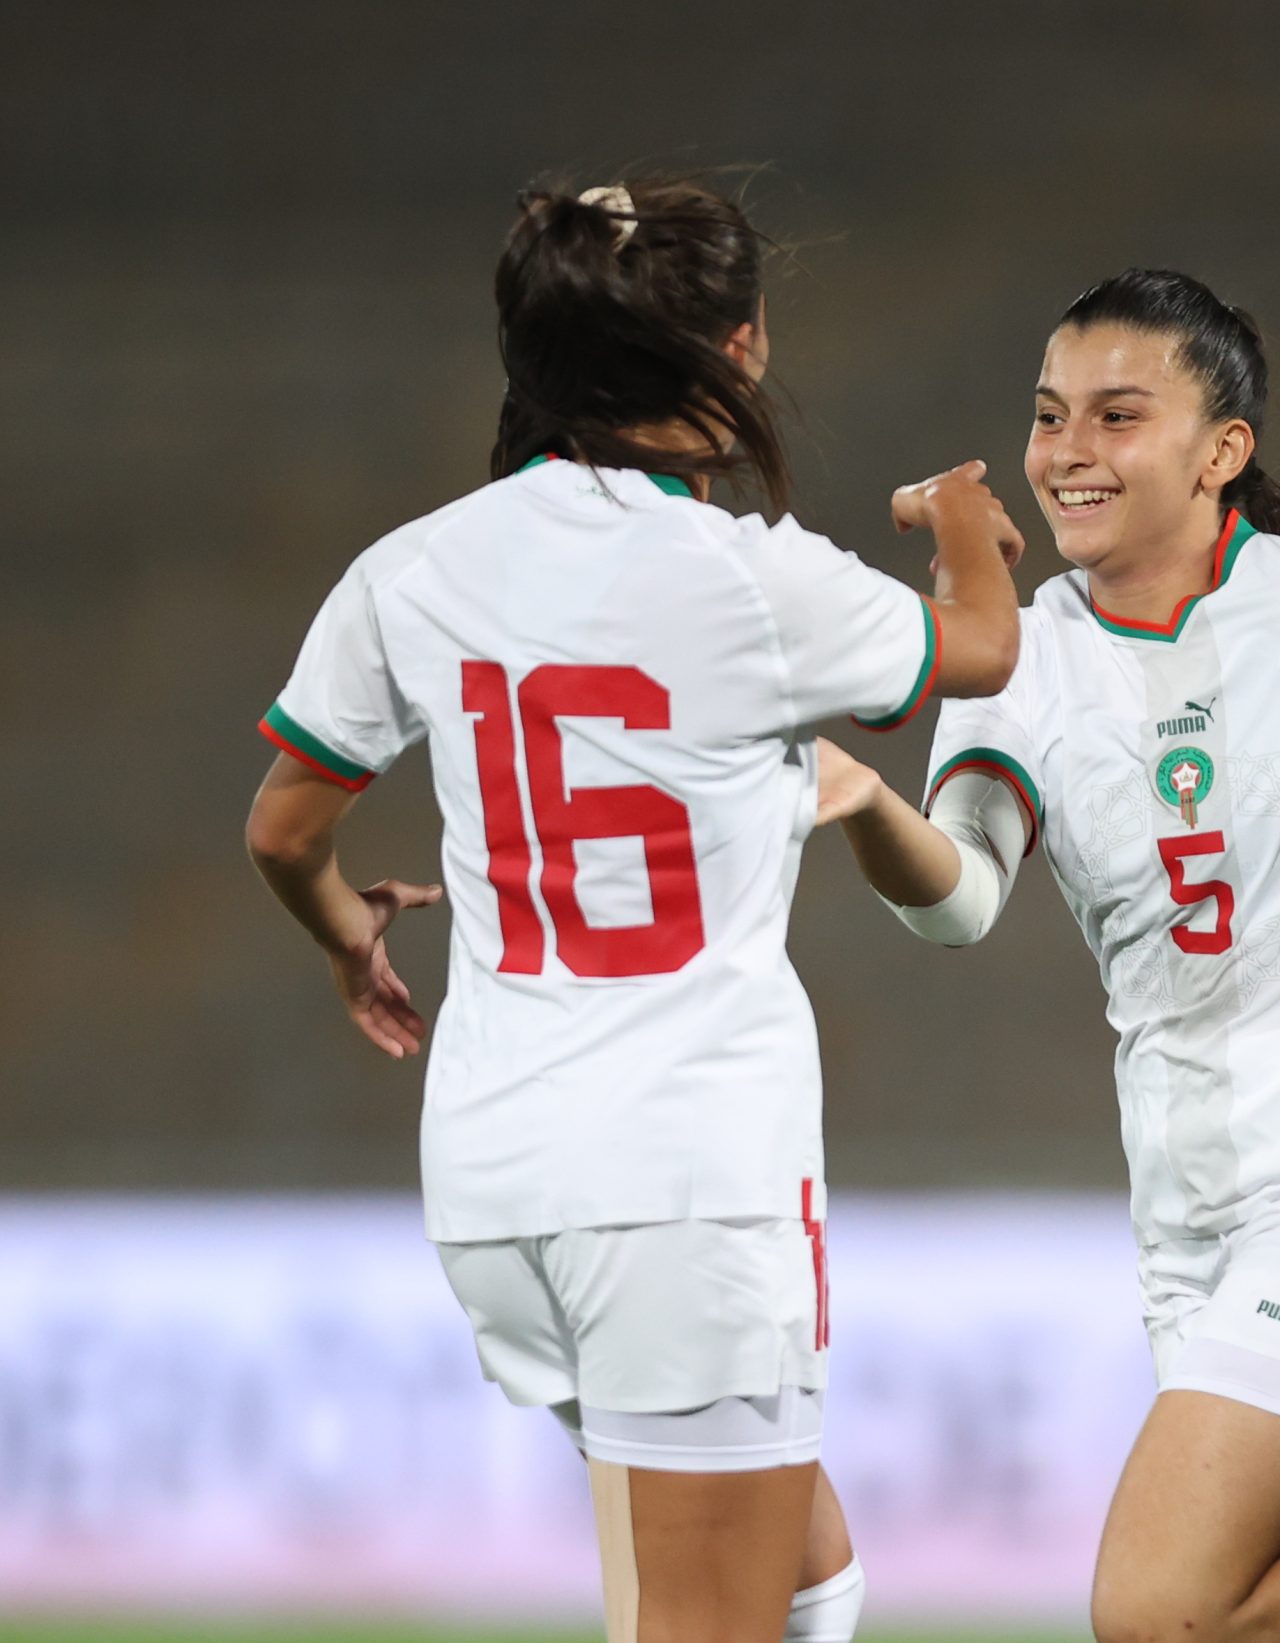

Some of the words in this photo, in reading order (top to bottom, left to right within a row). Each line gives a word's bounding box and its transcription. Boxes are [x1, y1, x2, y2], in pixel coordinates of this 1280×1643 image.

[1156, 715, 1206, 739] PUMA
[461, 659, 707, 978] 16
[1157, 830, 1235, 955] 5
